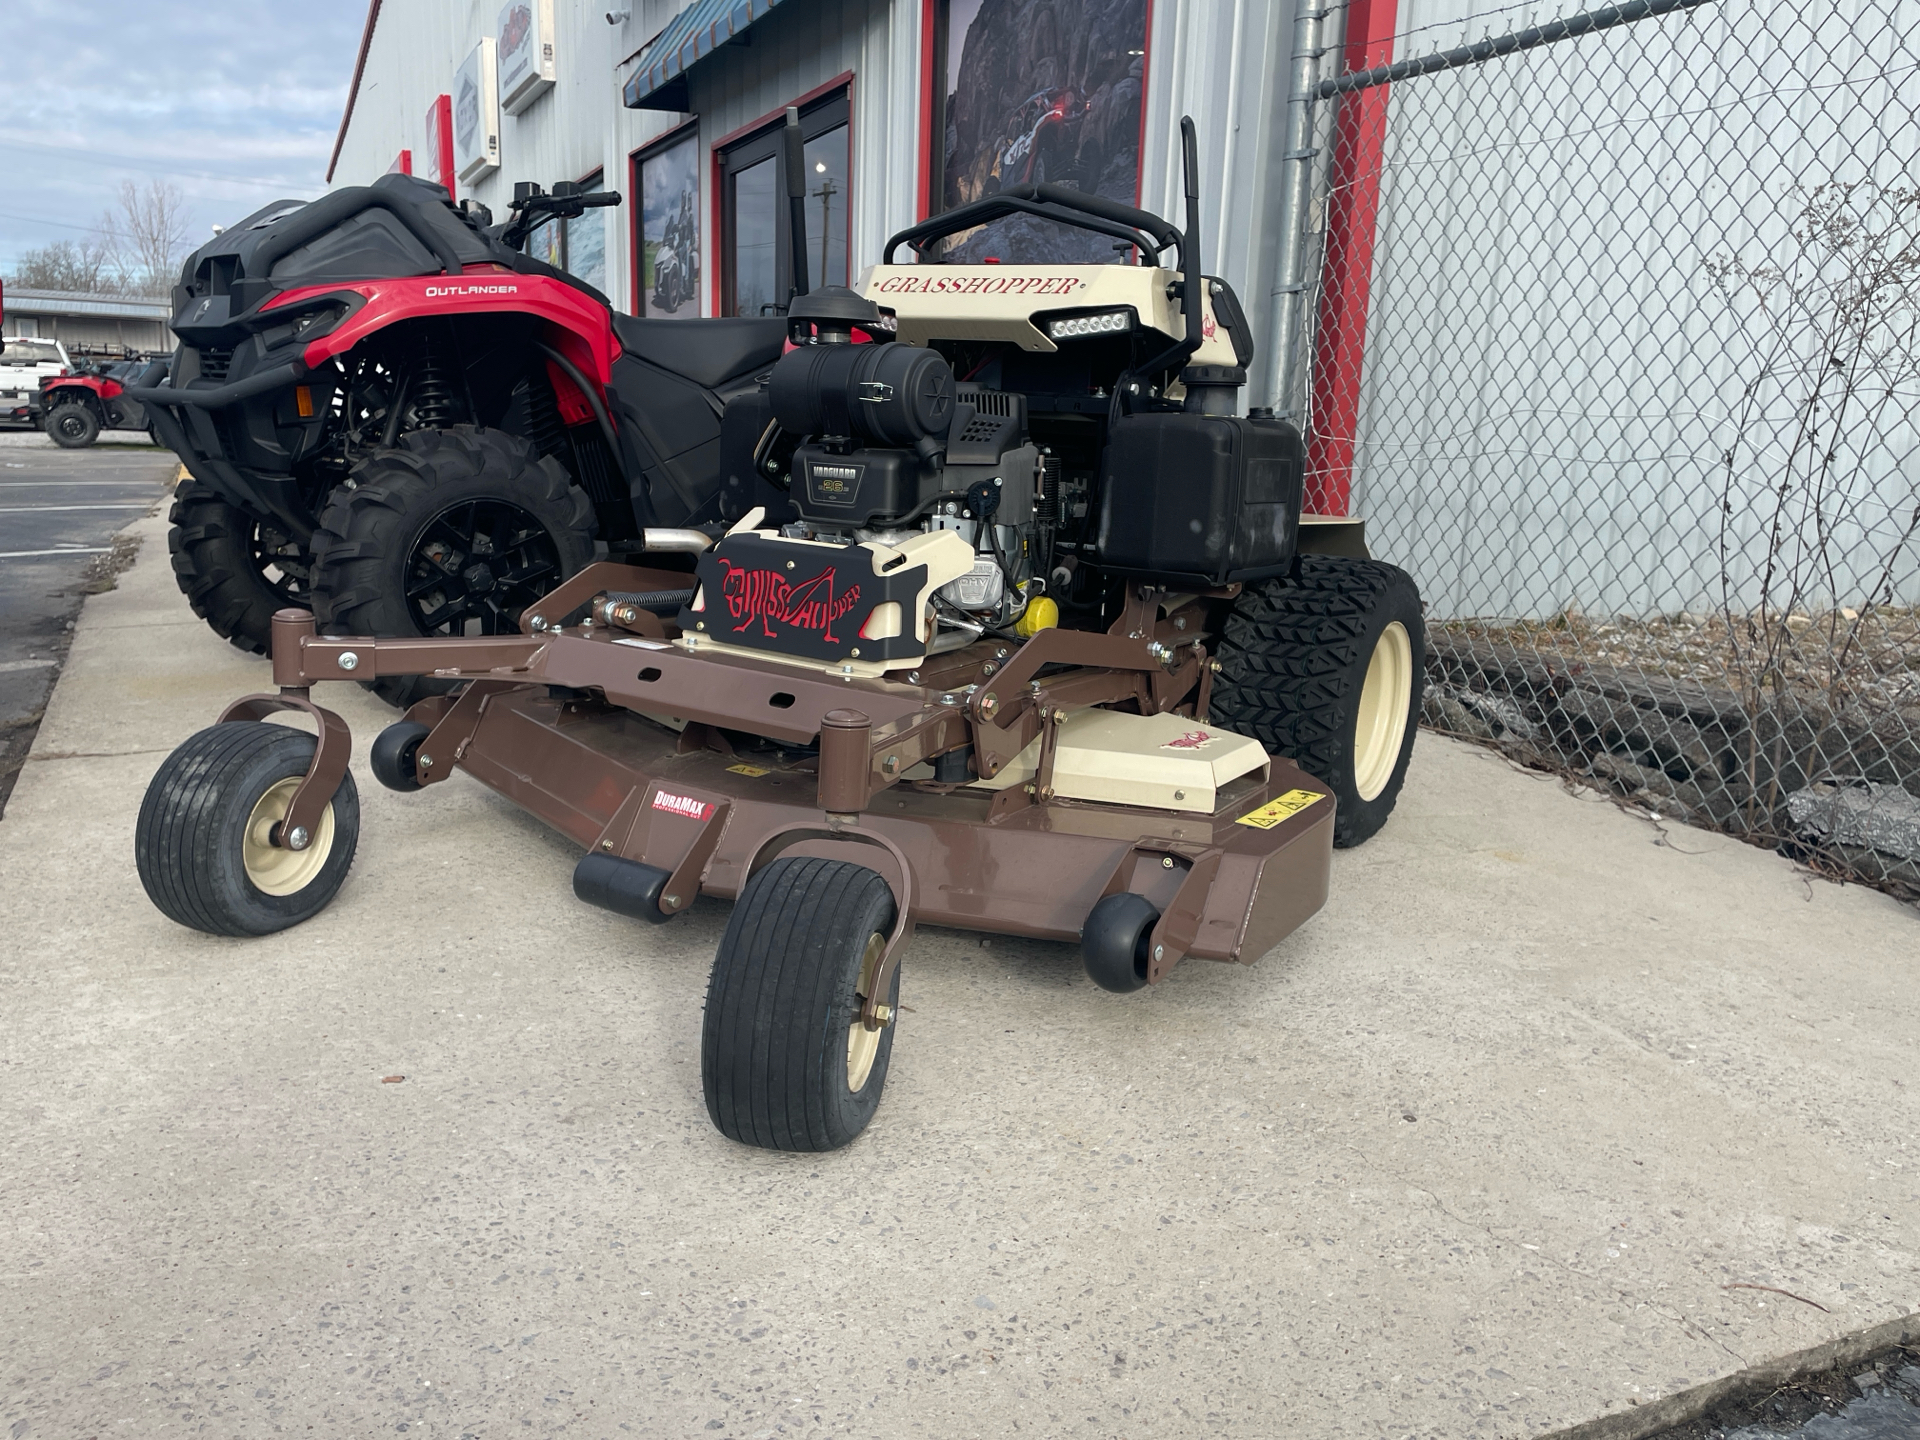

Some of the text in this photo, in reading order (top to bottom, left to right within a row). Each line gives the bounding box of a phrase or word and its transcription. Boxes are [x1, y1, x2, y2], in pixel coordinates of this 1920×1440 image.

[425, 285, 518, 298] OUTLANDER
[879, 276, 1080, 295] GRASSHOPPER
[813, 465, 857, 480] VANGUARD
[822, 479, 844, 493] 26
[959, 577, 989, 587] OHV
